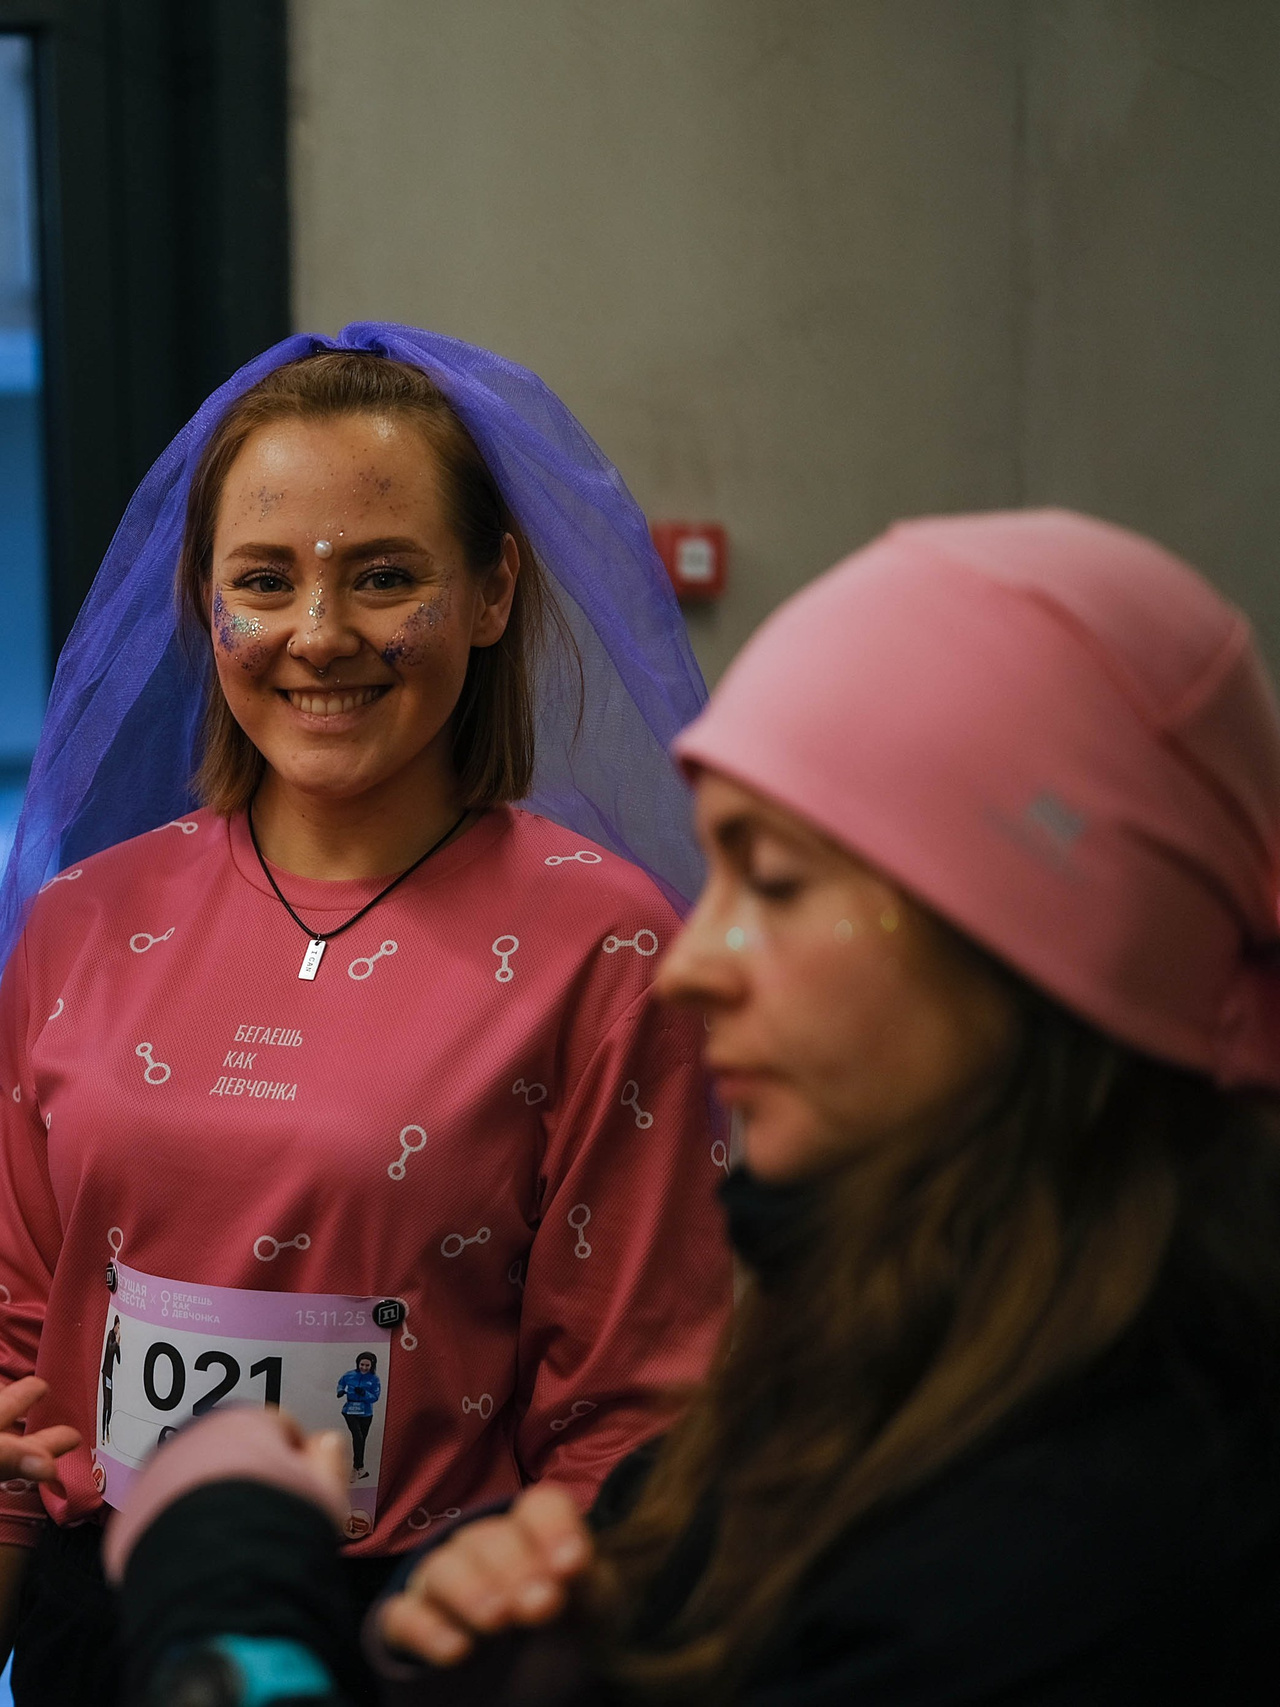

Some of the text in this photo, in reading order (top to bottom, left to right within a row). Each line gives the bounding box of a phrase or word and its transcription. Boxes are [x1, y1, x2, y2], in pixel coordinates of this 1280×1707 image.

[234, 1024, 304, 1047] БЕГАЕШЬ
[222, 1050, 257, 1070] КАК
[209, 1076, 298, 1101] ДЕВЧОНКА
[118, 1275, 147, 1297] ЕГУЩАЯ
[172, 1292, 213, 1306] БЕГАЕШЬ
[172, 1301, 191, 1312] КАК
[172, 1310, 221, 1324] ДЕВЧОНКА
[295, 1309, 366, 1327] 15.11.25
[143, 1341, 282, 1416] 021
